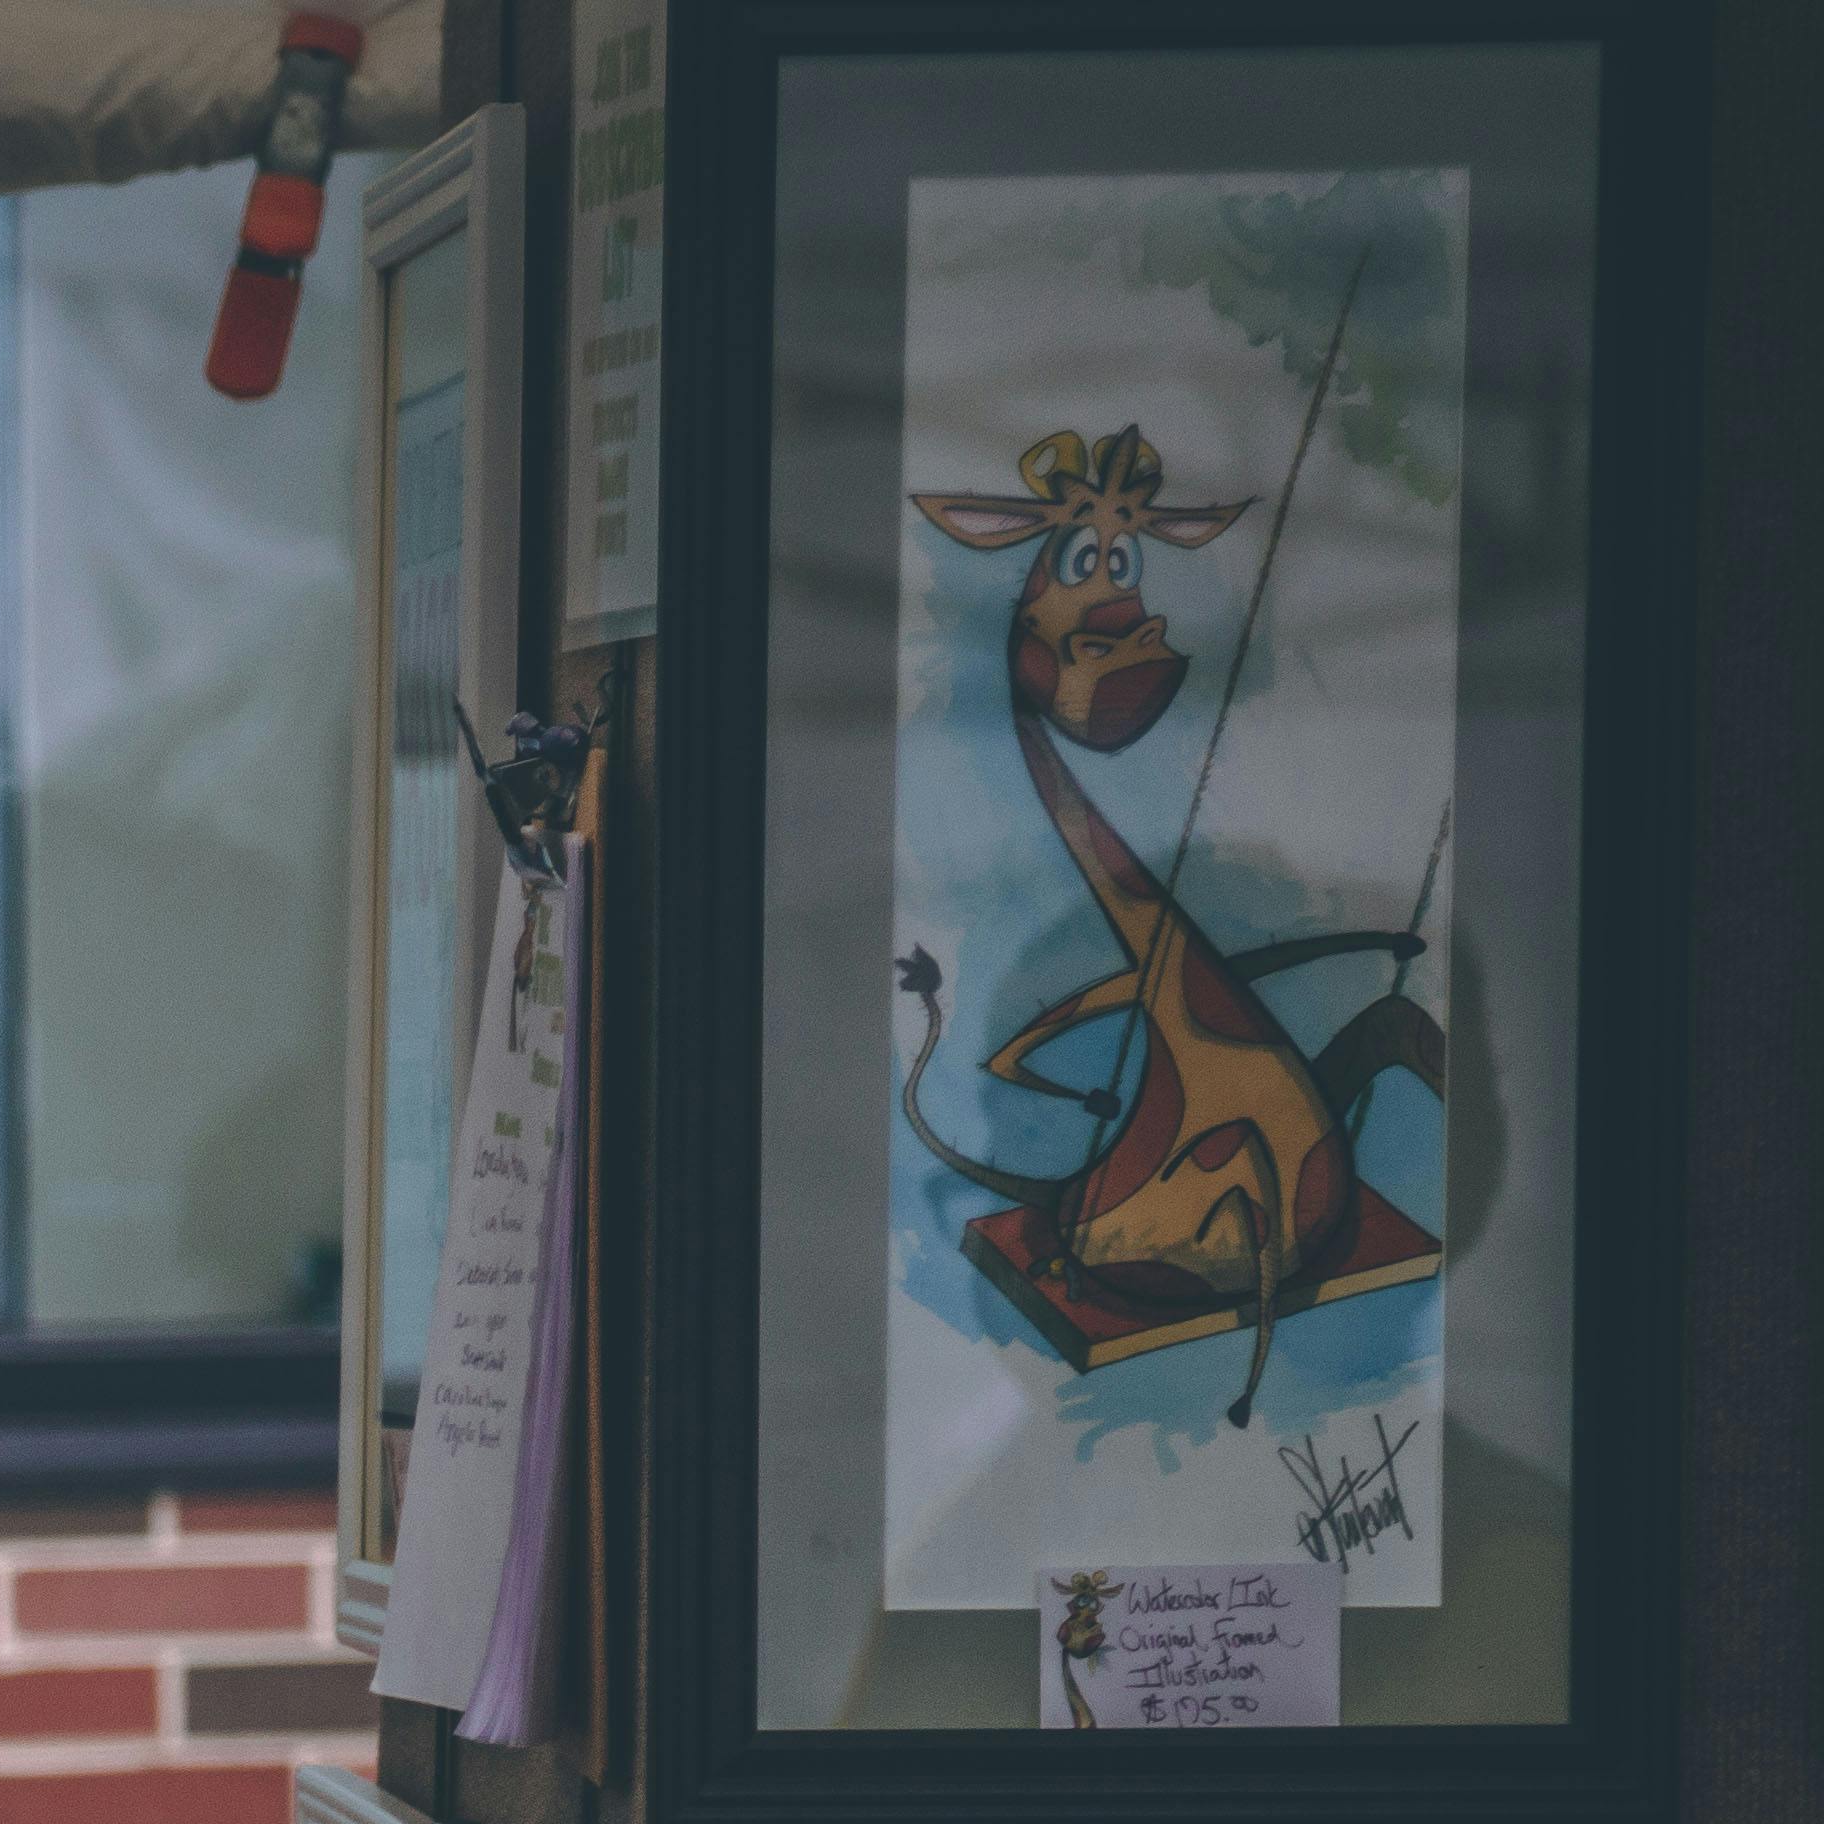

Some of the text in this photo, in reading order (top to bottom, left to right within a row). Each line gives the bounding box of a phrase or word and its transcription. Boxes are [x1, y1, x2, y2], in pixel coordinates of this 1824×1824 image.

[1119, 1616, 1304, 1659] Original Framed
[1124, 1650, 1266, 1689] Illustration
